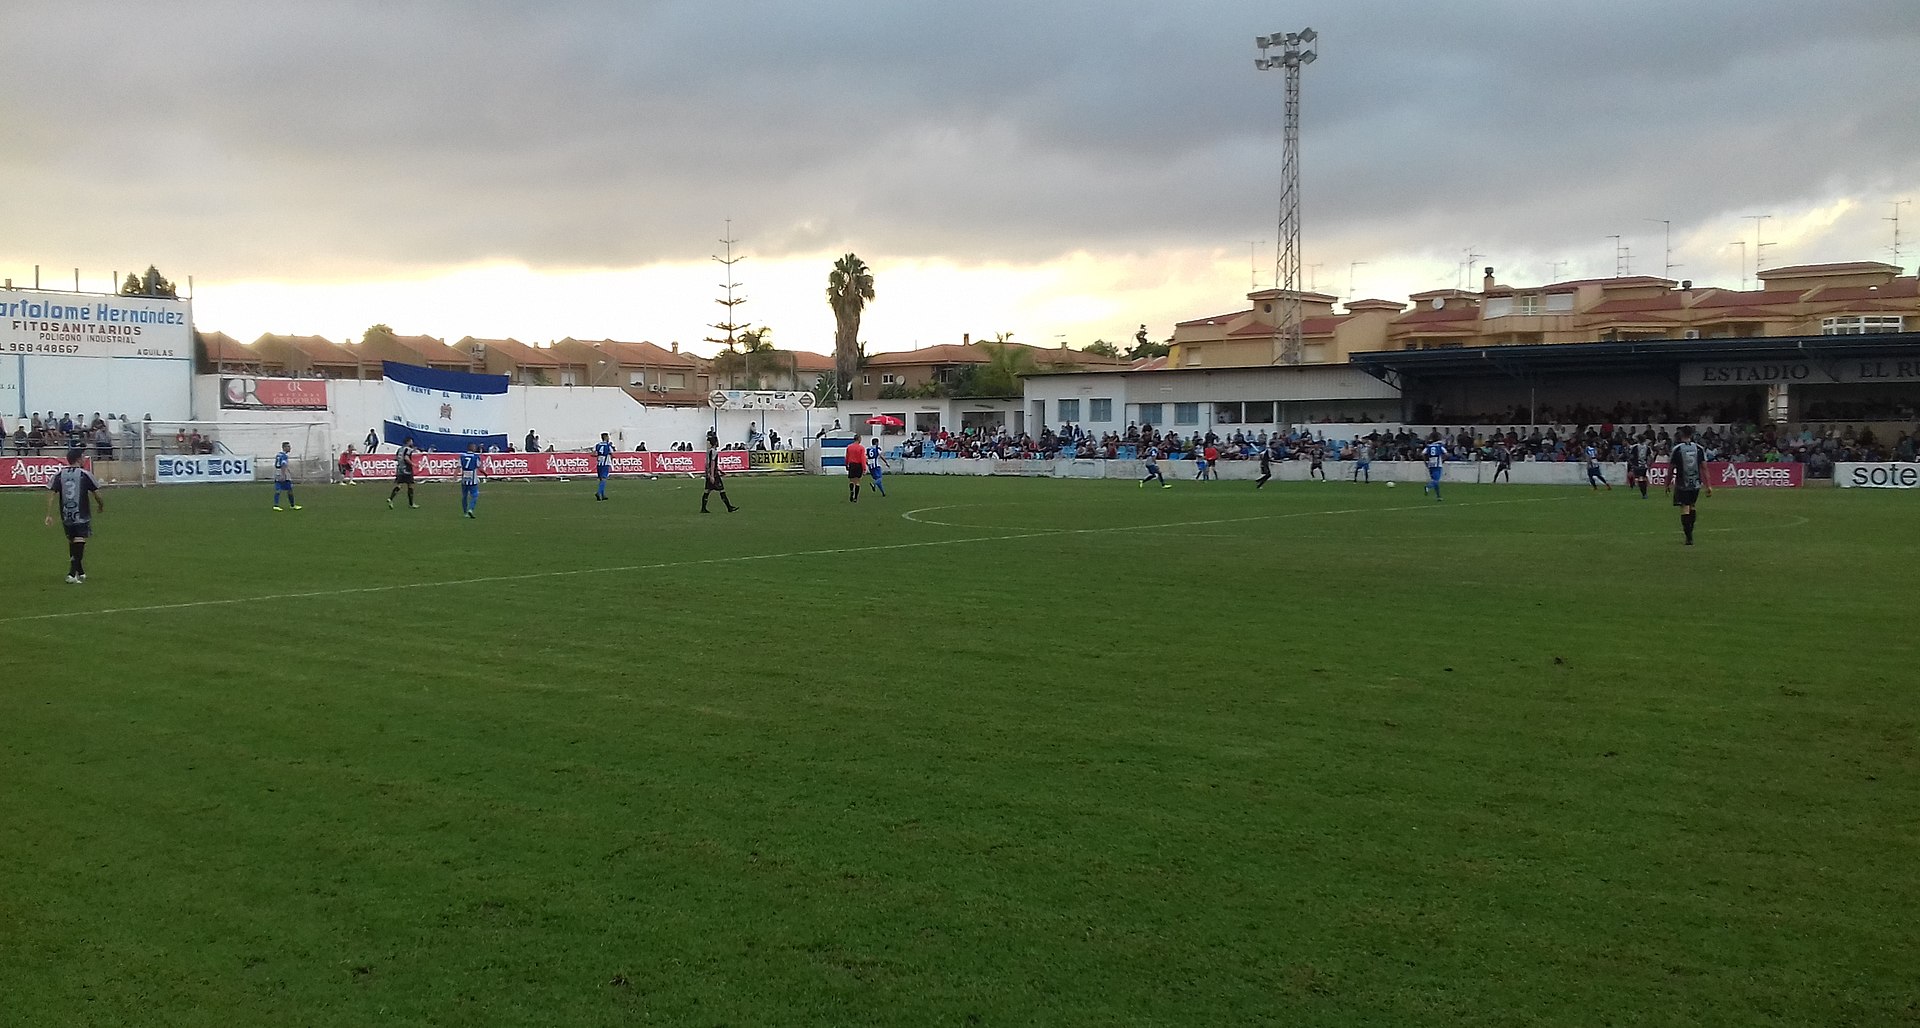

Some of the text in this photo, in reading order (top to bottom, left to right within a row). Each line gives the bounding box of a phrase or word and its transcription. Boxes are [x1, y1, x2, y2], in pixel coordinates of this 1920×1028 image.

[97, 303, 184, 325] Hernández
[12, 320, 142, 336] FITOSANITARIOS
[86, 335, 136, 344] INDUSTRIAL
[1703, 364, 1810, 381] ESTADIO
[1861, 362, 1889, 378] EL
[10, 459, 64, 483] Apuest
[174, 459, 252, 476] CSL CSL
[465, 457, 472, 469] 7
[482, 455, 528, 474] Apuestas
[546, 454, 589, 473] Apuestas
[655, 453, 693, 471] Apuestas
[1722, 463, 1791, 486] Apuestas
